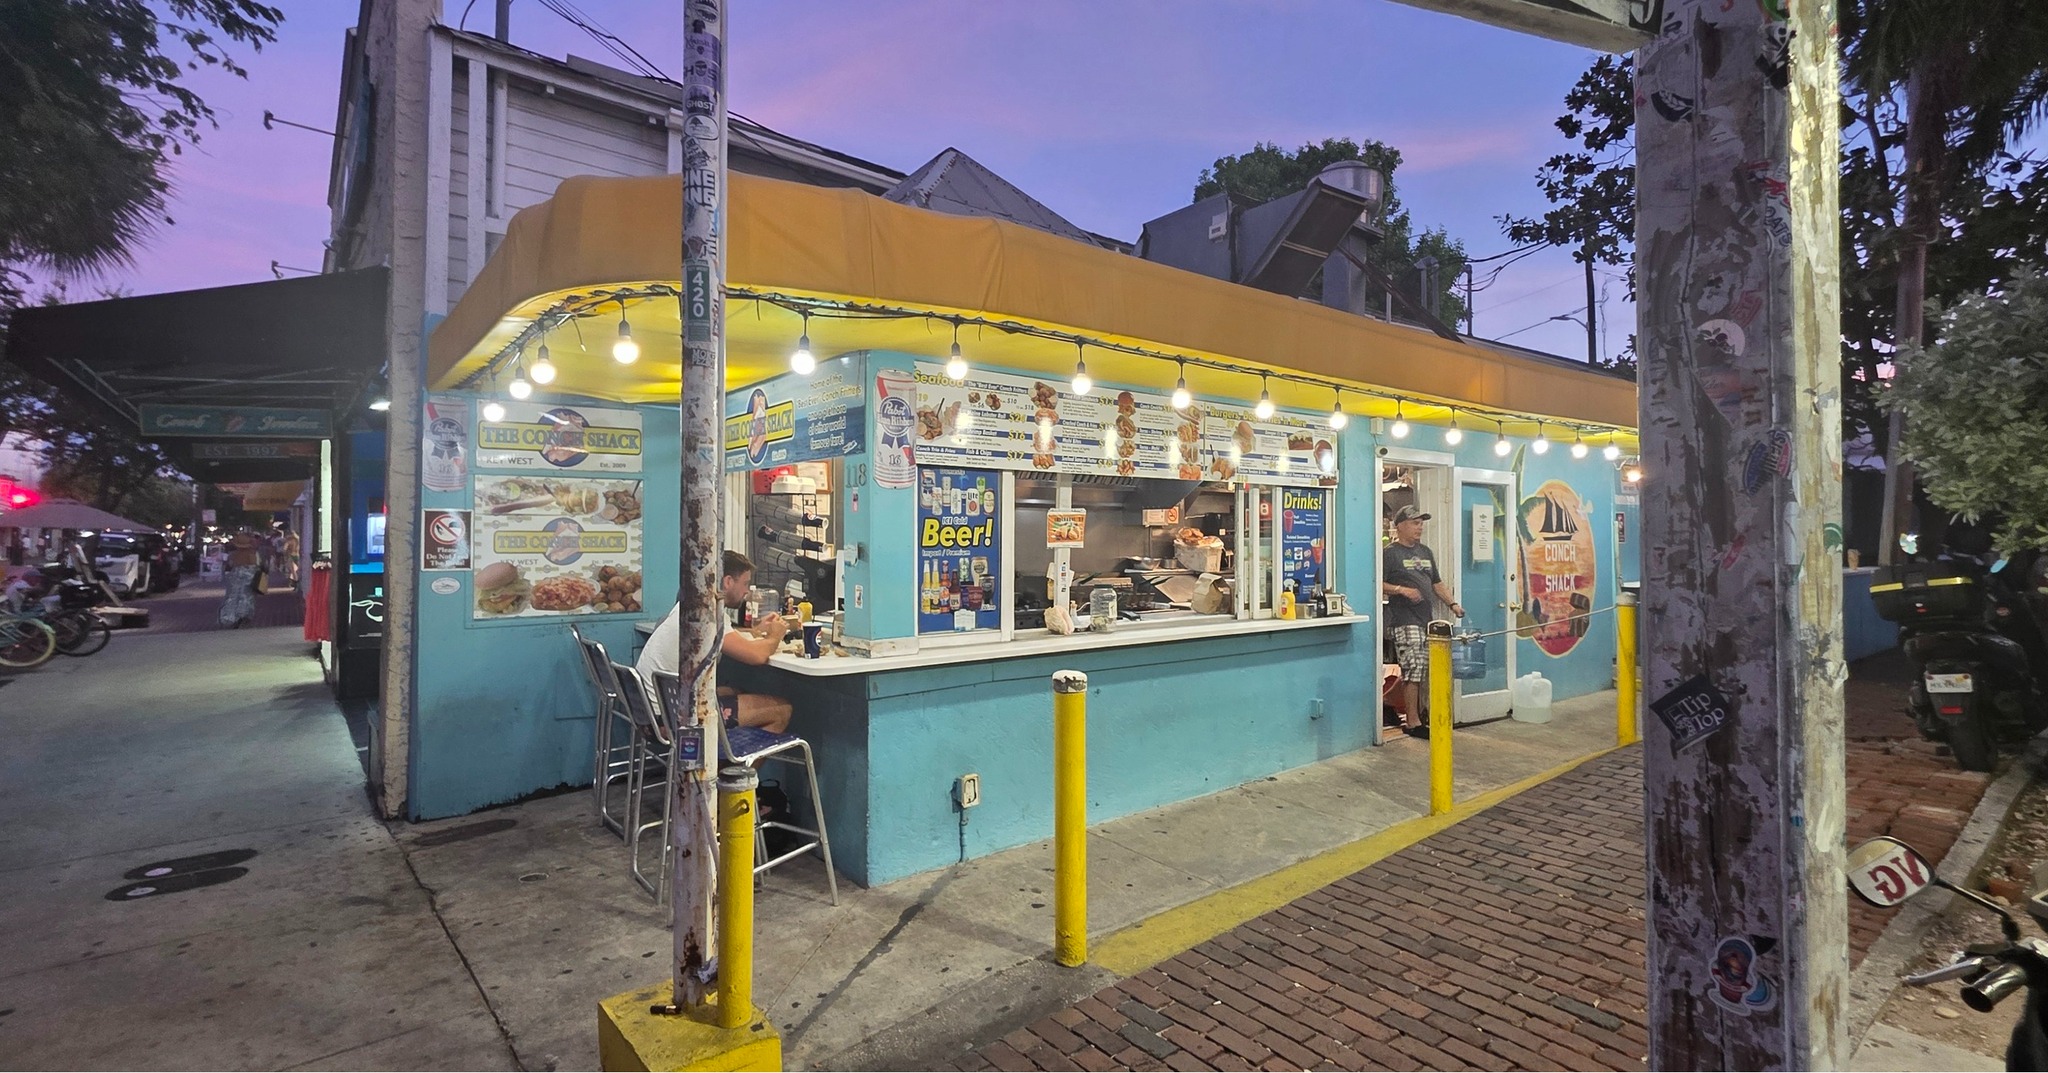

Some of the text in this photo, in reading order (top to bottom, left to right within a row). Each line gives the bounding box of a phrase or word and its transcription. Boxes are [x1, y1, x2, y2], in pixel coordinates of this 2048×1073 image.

[914, 371, 964, 388] Seafood
[884, 400, 907, 417] Pabst
[767, 408, 793, 436] SHACK
[482, 426, 640, 450] THE CONCH SHACK
[1008, 431, 1026, 441] $16
[507, 456, 534, 465] WEST
[889, 454, 902, 466] 16
[1007, 450, 1024, 461] $17
[845, 463, 867, 488] 118
[967, 491, 979, 501] Lite
[1284, 492, 1322, 510] Drinks!
[952, 516, 967, 525] Cold
[921, 517, 994, 547] Beer!
[497, 536, 625, 548] THE CONCH SHACK
[921, 548, 942, 557] Import
[946, 549, 971, 557] Premium
[1544, 543, 1577, 562] CONCH
[1544, 574, 1577, 593] SHACK
[1678, 692, 1711, 716] Tip
[1691, 707, 1725, 730] Top
